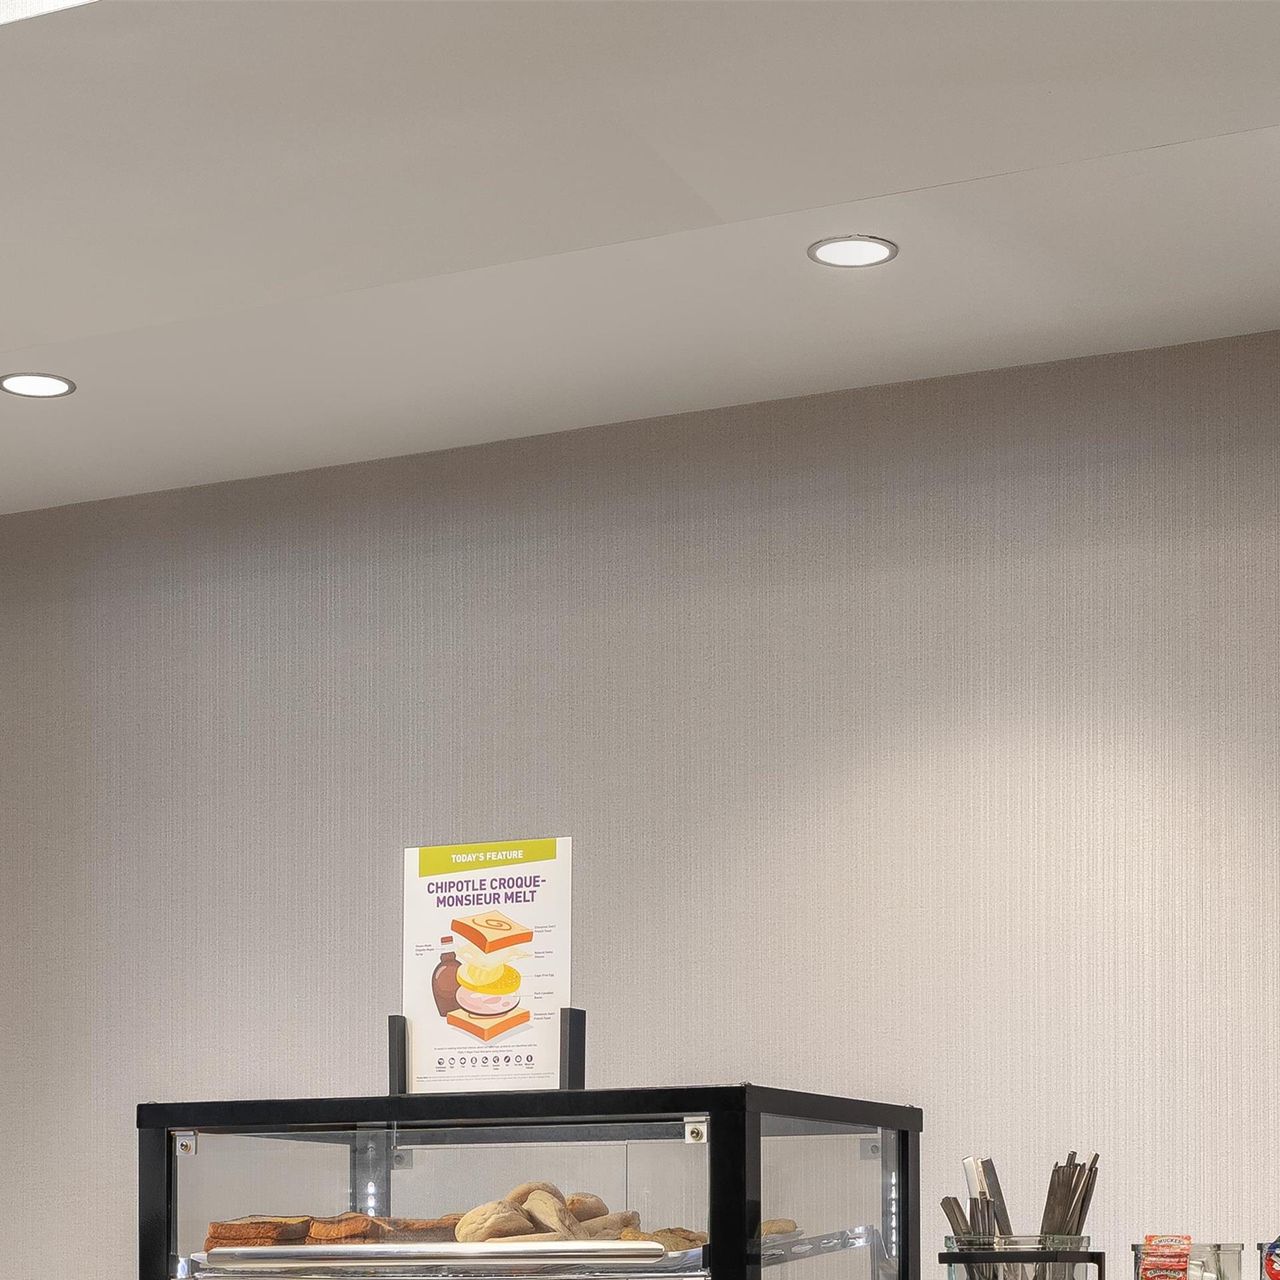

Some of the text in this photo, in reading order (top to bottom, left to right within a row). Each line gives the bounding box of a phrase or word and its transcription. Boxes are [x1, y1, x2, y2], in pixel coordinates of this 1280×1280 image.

[451, 850, 523, 863] TODAY'S FEATURE
[427, 875, 546, 894] CHIPOTLE CROQUE-
[436, 890, 537, 908] MONSIEUR MELT
